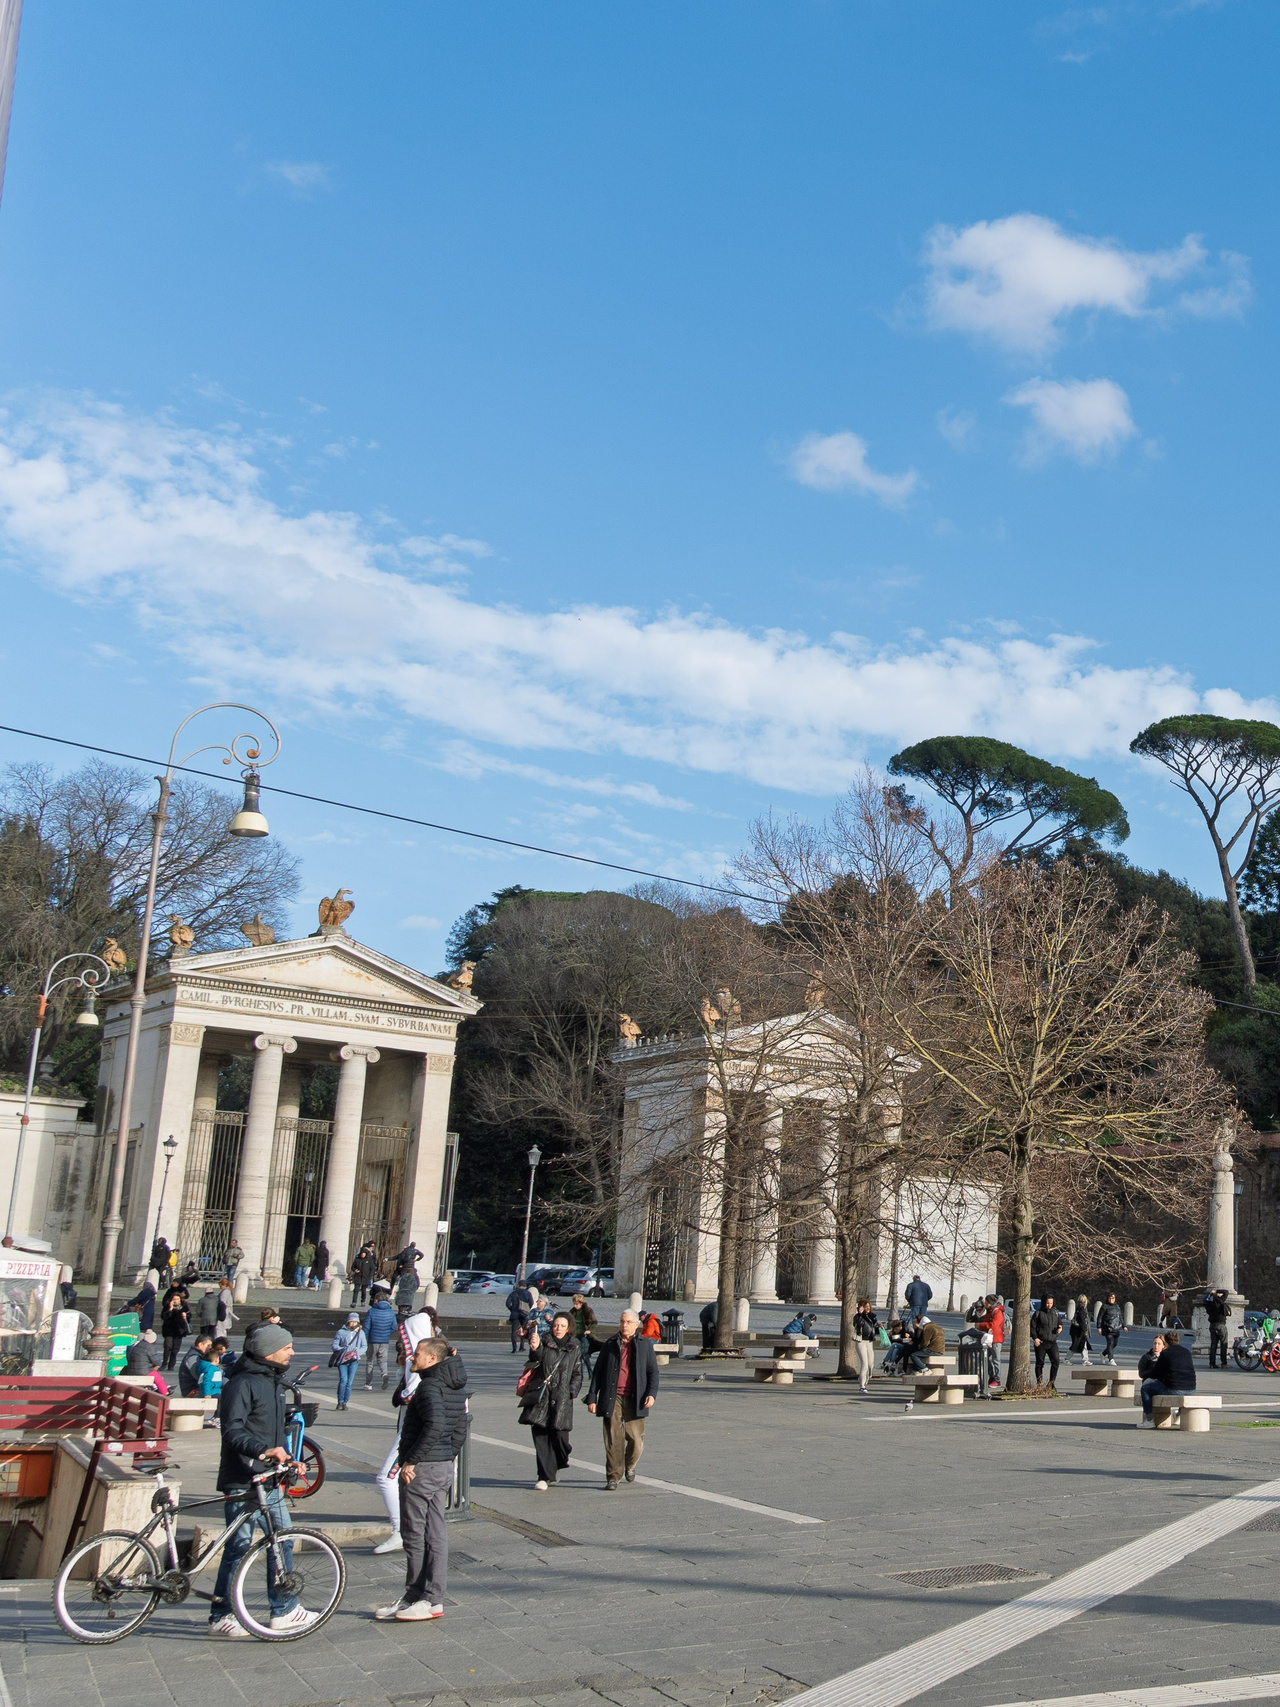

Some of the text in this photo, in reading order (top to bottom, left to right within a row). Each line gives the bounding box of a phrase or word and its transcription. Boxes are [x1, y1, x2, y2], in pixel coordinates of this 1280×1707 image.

[221, 994, 284, 1013] BVRGHESIVS
[291, 1004, 305, 1015] PR
[311, 1007, 348, 1021] VILLAM
[354, 1012, 380, 1025] SVAM
[386, 1017, 452, 1035] SVBVRBANAM
[6, 1262, 51, 1277] PIZZERIA
